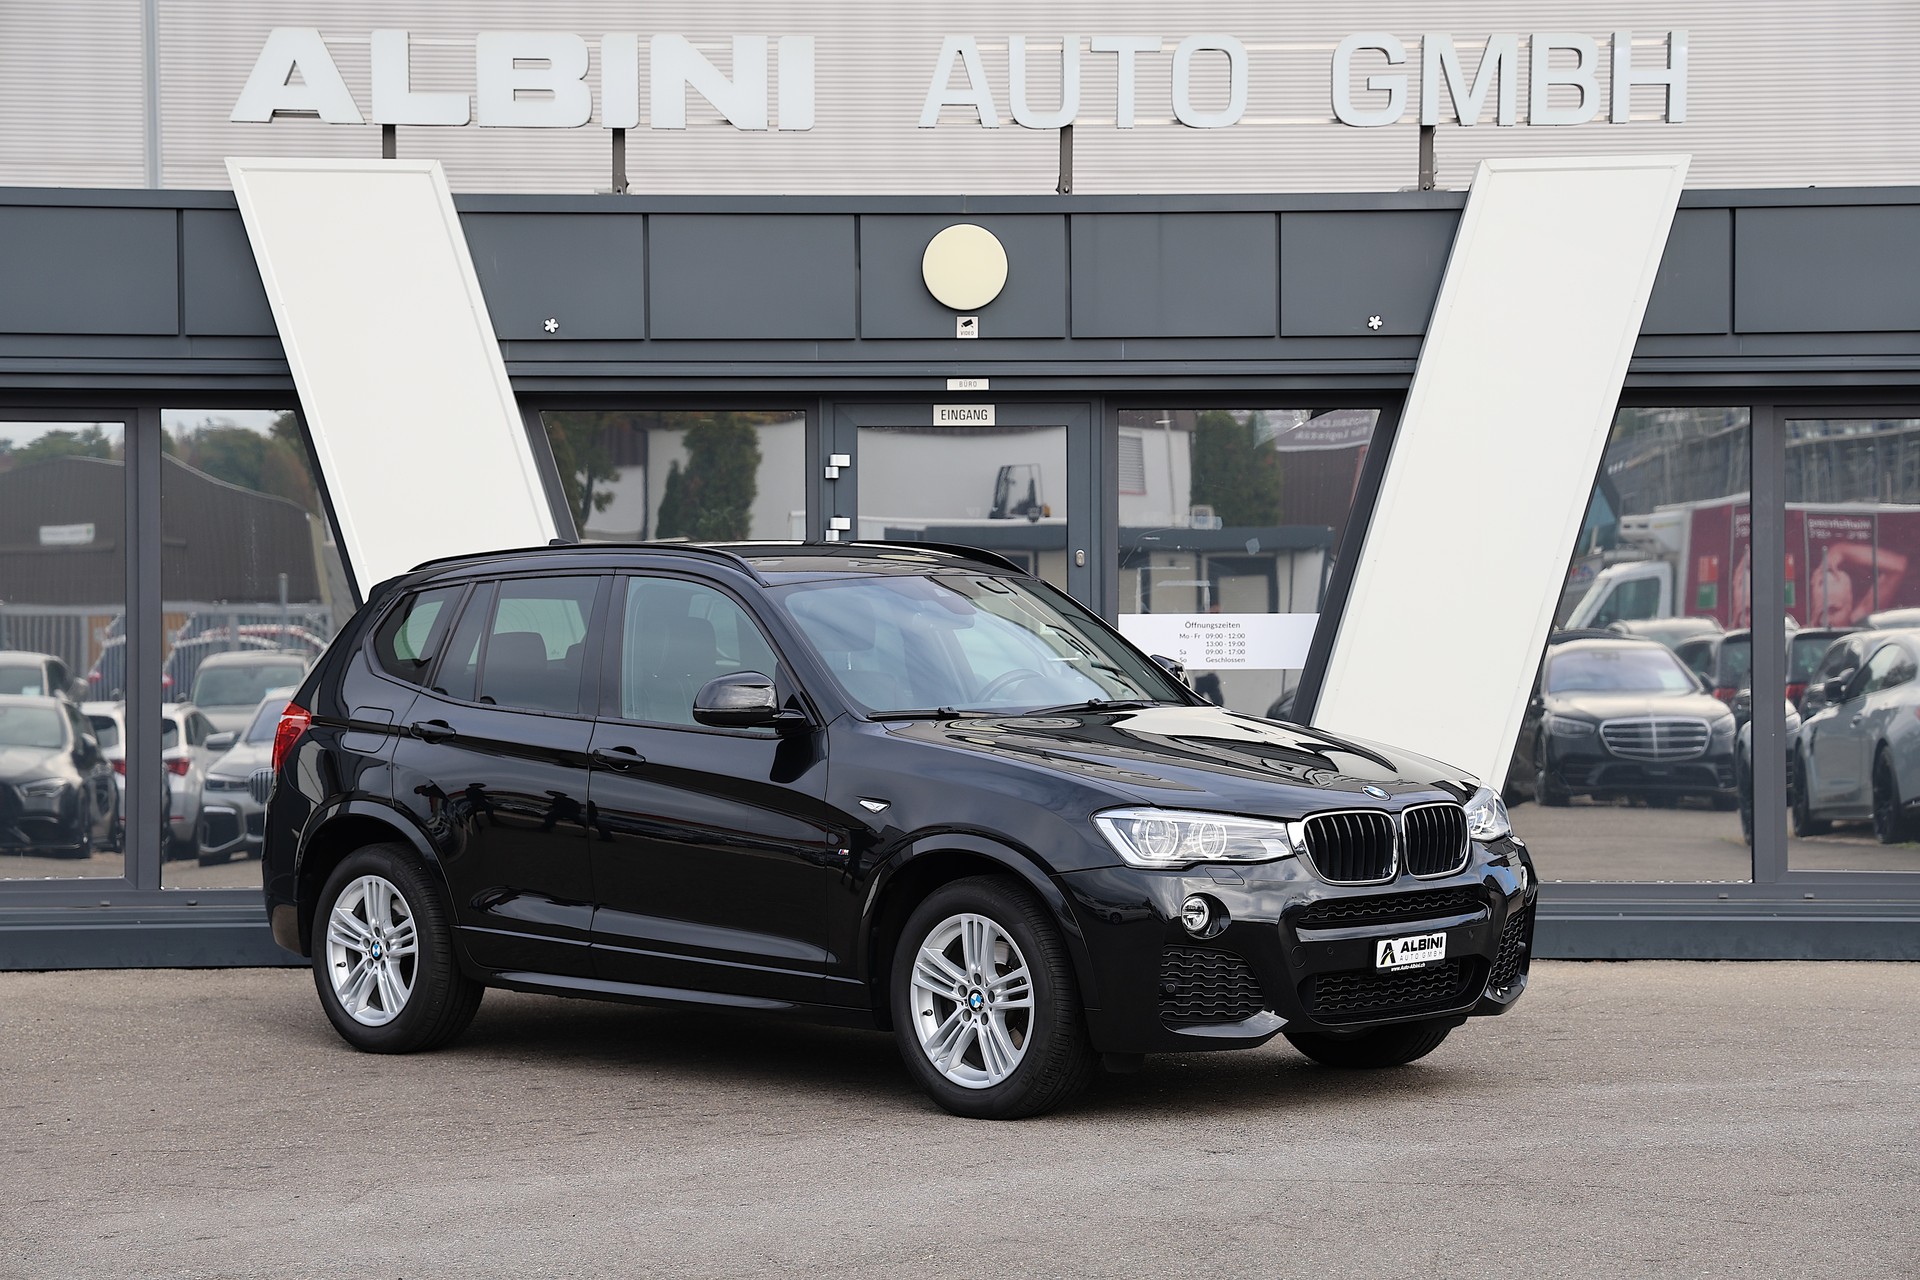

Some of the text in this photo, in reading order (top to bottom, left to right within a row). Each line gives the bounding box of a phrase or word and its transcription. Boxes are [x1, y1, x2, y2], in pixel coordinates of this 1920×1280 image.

[230, 27, 1689, 131] ALBINI AUTO GMBH
[959, 380, 978, 388] BÜRO
[941, 409, 988, 421] EINGANG
[1185, 620, 1241, 629] Öffnungszeiten
[1400, 936, 1443, 953] ALBINI
[1400, 950, 1443, 961] AUTO GMBH
